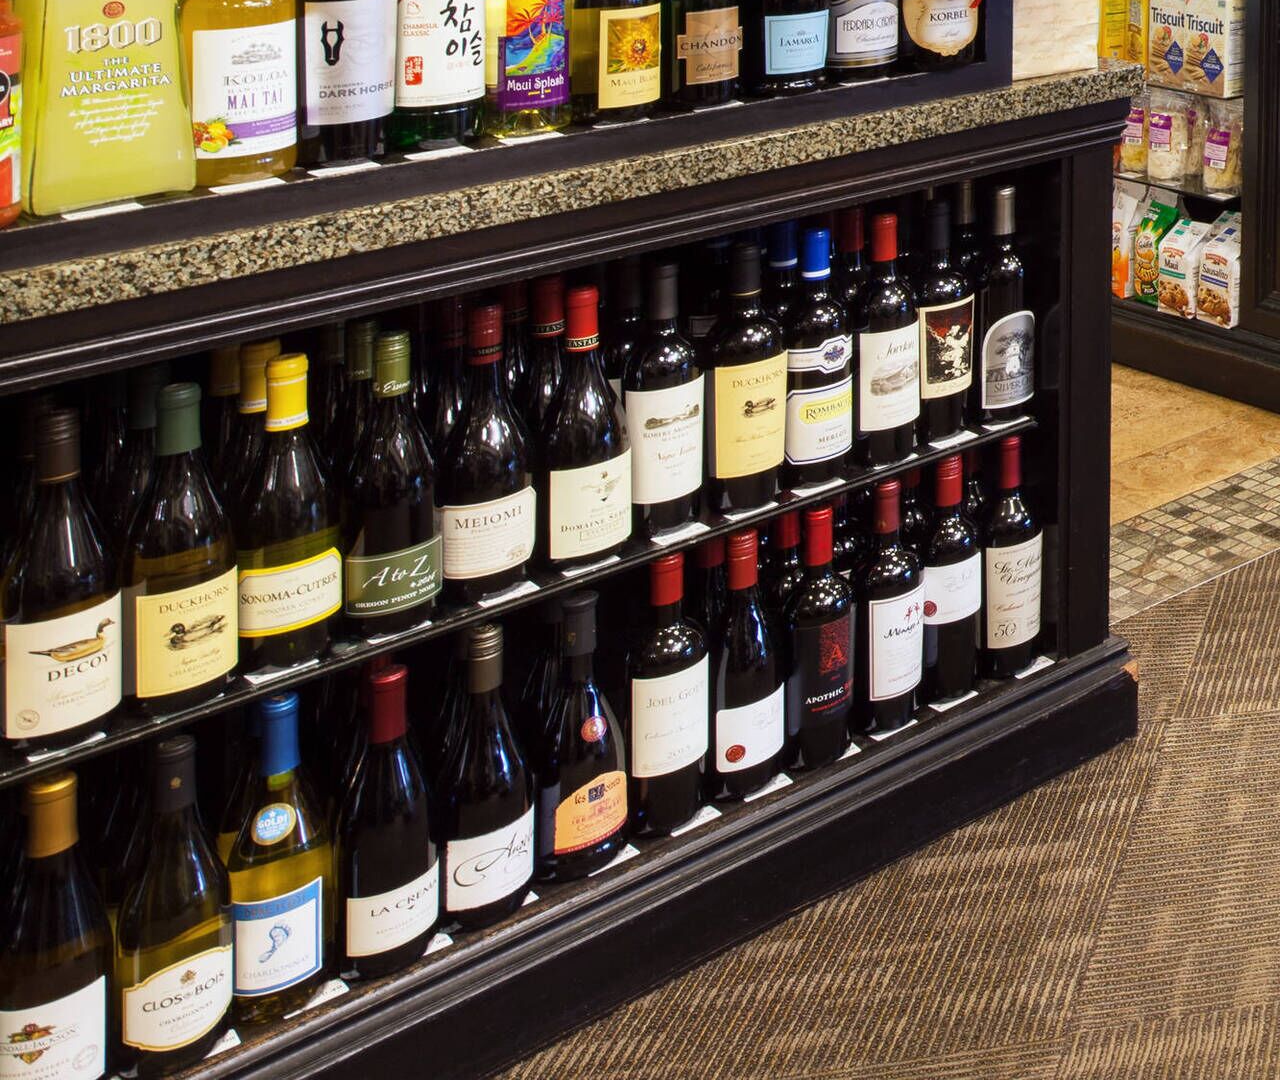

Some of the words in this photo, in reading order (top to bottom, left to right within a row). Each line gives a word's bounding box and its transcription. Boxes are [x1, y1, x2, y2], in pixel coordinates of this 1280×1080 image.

[929, 10, 970, 23] KORBEL
[1150, 6, 1184, 29] Triscuit
[1186, 13, 1225, 36] Triscuit
[63, 17, 163, 55] 1800
[680, 33, 742, 52] CHANDON
[103, 56, 130, 66] THE
[69, 63, 162, 84] ULTIMATE
[59, 75, 173, 98] MARGARITA
[319, 87, 359, 100] DARK
[534, 73, 565, 99] Splash
[227, 93, 257, 110] MAI
[263, 88, 283, 105] TAI
[453, 504, 524, 532] MEIOMI
[361, 566, 386, 590] A
[405, 553, 431, 578] Z
[158, 584, 231, 615] DUCKHORN
[239, 569, 339, 607] SONOMA-CUTRER
[390, 591, 417, 605] PINOT
[47, 652, 112, 684] DECOY
[804, 686, 845, 706] APOTHIC
[370, 905, 392, 919] LA
[393, 877, 437, 914] CREMA
[141, 993, 184, 1014] CLOS
[193, 970, 225, 997] BOIS
